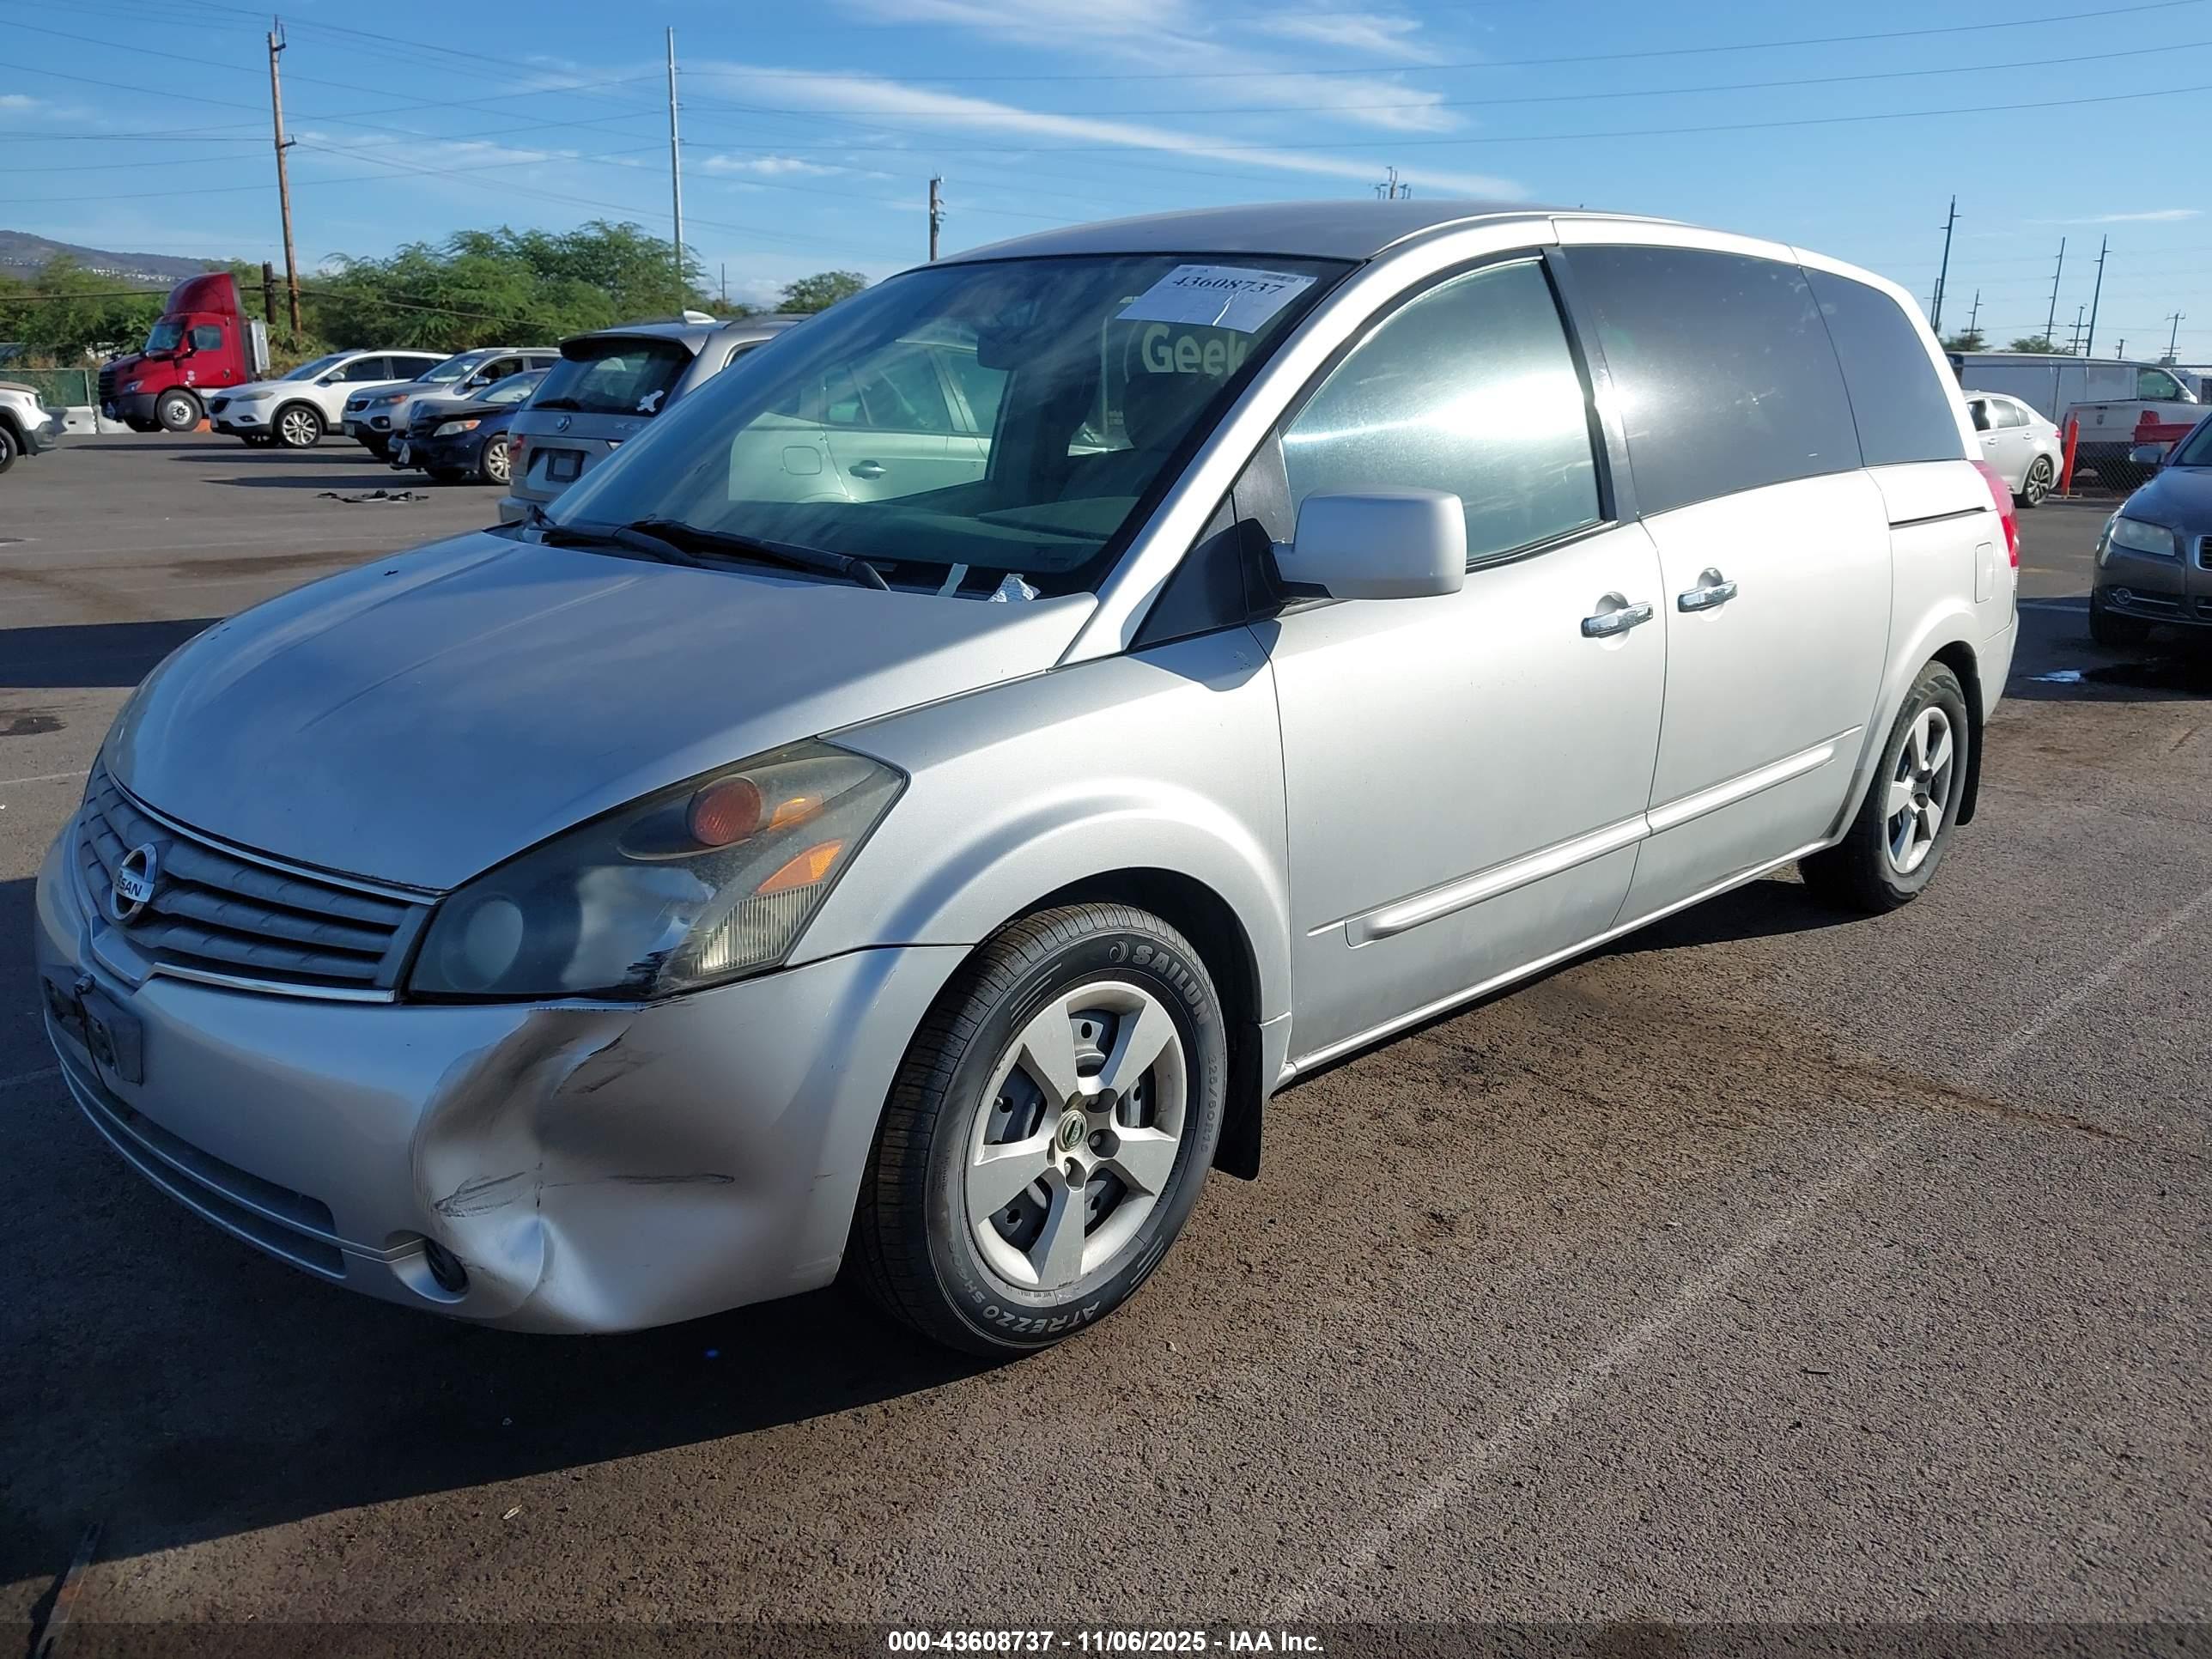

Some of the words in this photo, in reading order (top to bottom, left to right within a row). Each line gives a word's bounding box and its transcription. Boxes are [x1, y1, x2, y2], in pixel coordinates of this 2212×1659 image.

[1173, 276, 1285, 295] 43608737
[1142, 323, 1248, 377] Geek
[1132, 945, 1212, 1025] SAILUN
[982, 1300, 1101, 1334] ATREZZO
